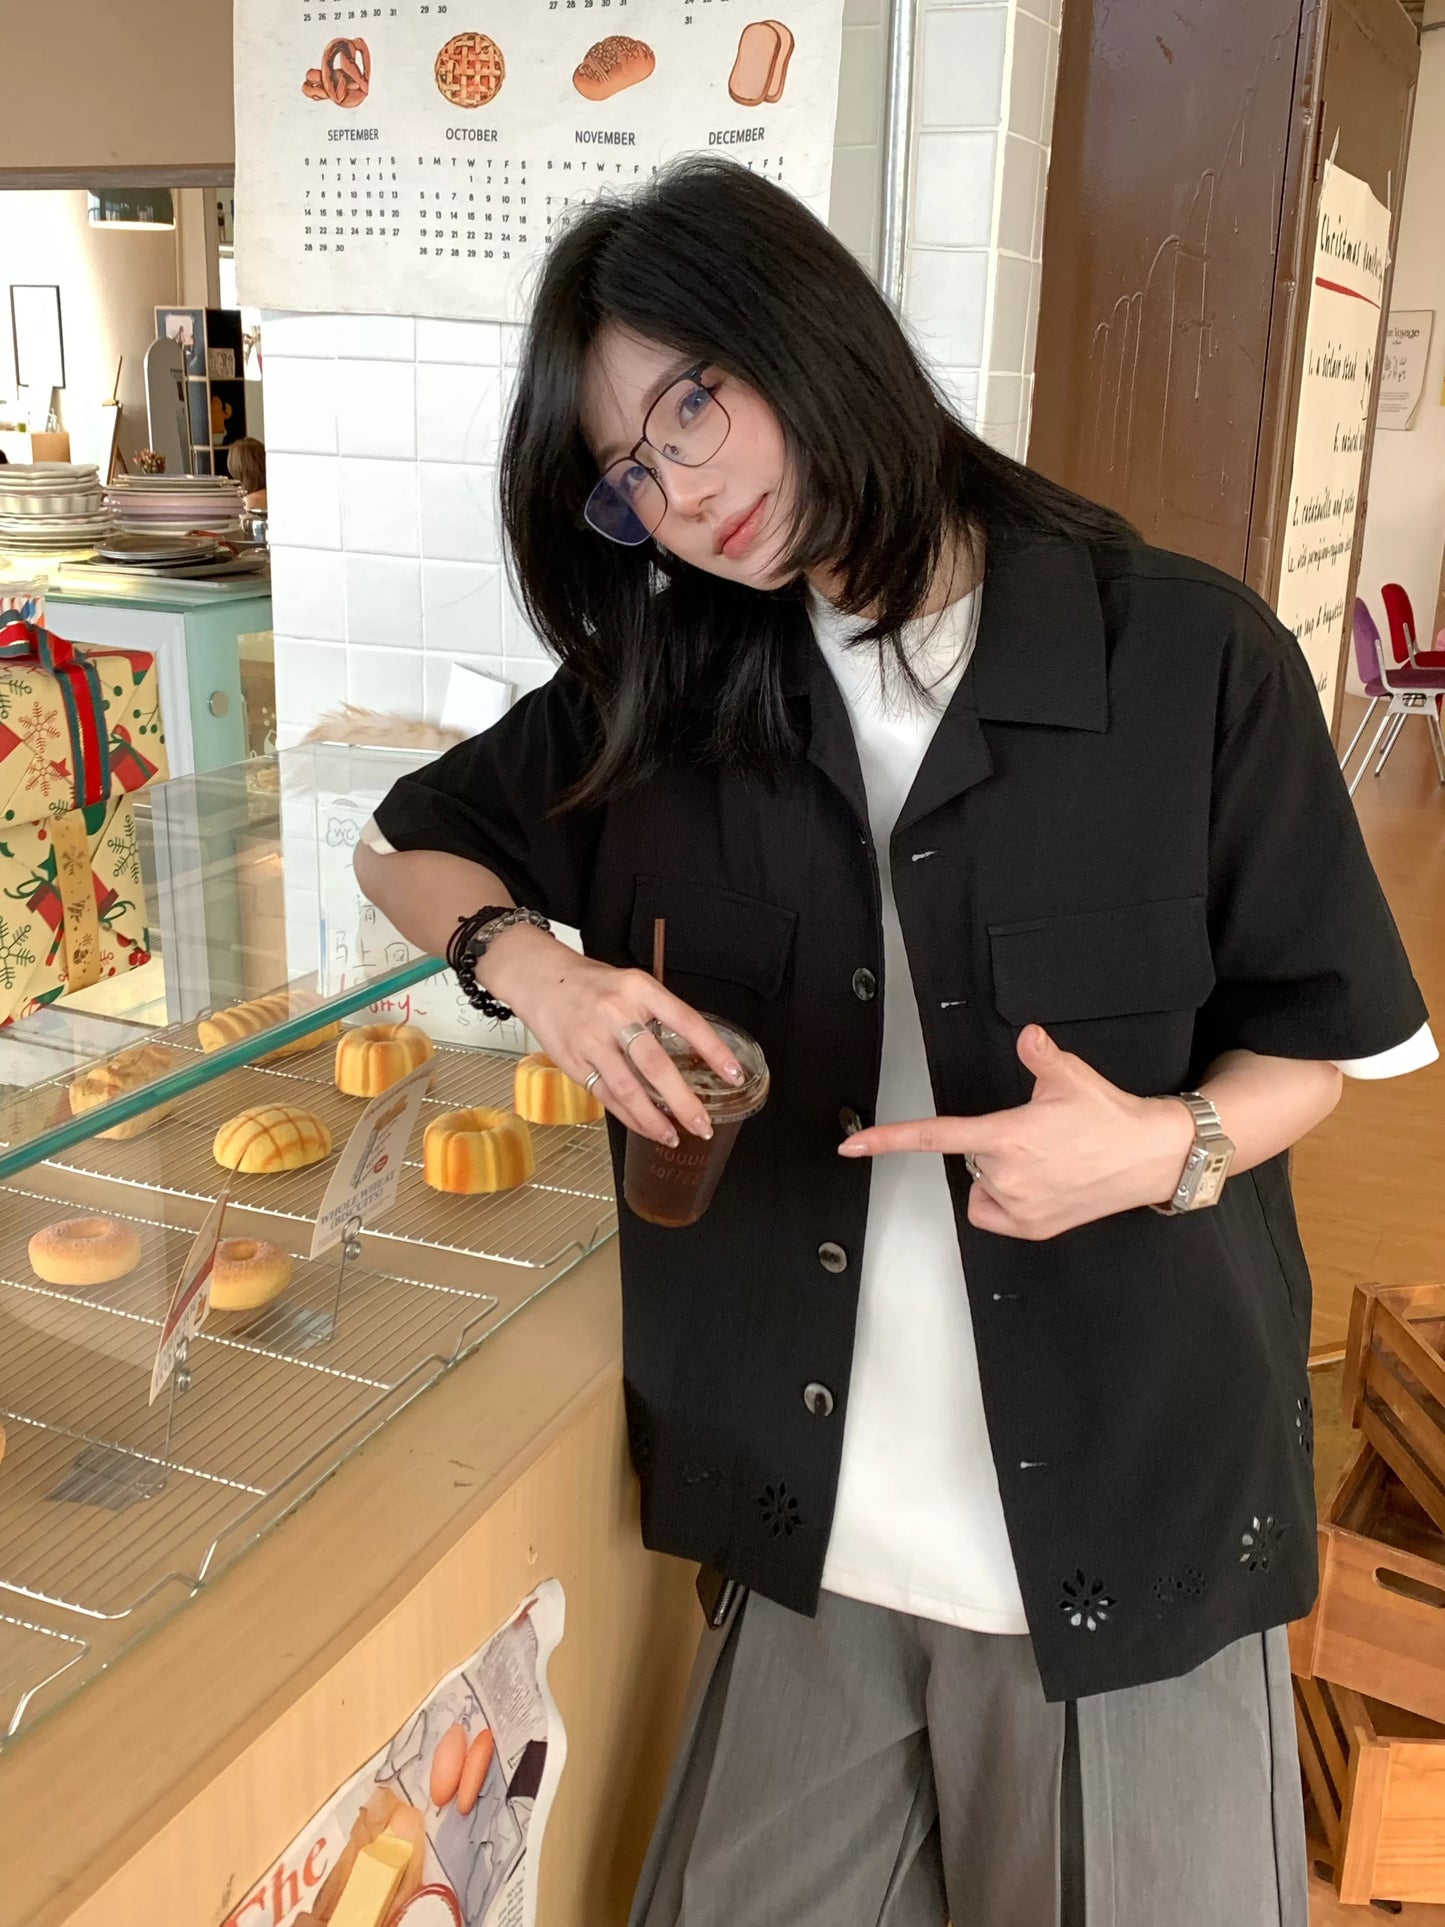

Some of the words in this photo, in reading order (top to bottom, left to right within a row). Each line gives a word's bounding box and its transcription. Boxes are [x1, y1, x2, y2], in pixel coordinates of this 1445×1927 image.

[419, 5, 430, 15] 29
[436, 4, 448, 14] 30
[548, 0, 559, 11] 27
[565, 0, 577, 9] 28
[583, 0, 594, 9] 29
[600, 0, 611, 8] 30
[303, 13, 312, 23] 25
[317, 12, 327, 21] 26
[333, 11, 343, 21] 27
[359, 9, 369, 19] 29
[372, 7, 382, 17] 30
[389, 7, 397, 17] 31
[684, 15, 693, 26] 31
[328, 128, 379, 141] SEPTEMBER
[446, 128, 498, 142] OCTOBER
[575, 130, 636, 146] NOVEMBER
[708, 127, 765, 145] DECEMBER
[304, 157, 311, 167] S
[319, 157, 328, 167] M
[335, 157, 342, 167] T
[349, 157, 358, 166] W
[365, 156, 371, 166] T
[377, 156, 383, 166] F
[390, 155, 396, 166] S
[417, 155, 424, 166] S
[432, 156, 442, 166] M
[451, 157, 457, 167] T
[466, 158, 476, 169] W
[486, 159, 493, 169] T
[503, 159, 510, 169] F
[520, 159, 527, 170] S
[546, 159, 553, 170] S
[562, 160, 572, 171] M
[581, 161, 588, 171] T
[595, 161, 605, 173] W
[615, 163, 622, 174] T
[633, 164, 640, 175] F
[763, 158, 769, 169] F
[778, 155, 784, 166] S
[305, 189, 311, 199] 7
[336, 190, 343, 199] 9
[349, 190, 358, 199] 10
[365, 190, 372, 199] 11
[391, 190, 399, 200] 13
[419, 190, 425, 200] 5
[434, 191, 441, 201] 6
[451, 191, 457, 201] 7
[468, 193, 475, 202] 8
[485, 194, 492, 203] 9
[501, 195, 511, 205] 10
[519, 195, 527, 205] 11
[303, 208, 312, 217] 14
[319, 208, 328, 217] 15
[335, 208, 344, 218] 16
[350, 208, 359, 217] 17
[365, 208, 373, 218] 18
[391, 209, 400, 219] 20
[419, 209, 427, 219] 12
[435, 210, 443, 220] 13
[449, 210, 459, 221] 14
[467, 211, 476, 221] 15
[484, 212, 493, 223] 16
[501, 213, 511, 223] 17
[518, 215, 527, 225] 18
[304, 225, 313, 235] 21
[318, 225, 328, 235] 22
[335, 226, 344, 236] 23
[350, 226, 360, 236] 24
[365, 226, 375, 236] 25
[391, 227, 401, 237] 27
[419, 228, 428, 238] 19
[434, 229, 445, 239] 20
[450, 229, 459, 239] 21
[466, 230, 477, 240] 22
[483, 231, 493, 241] 23
[500, 232, 511, 242] 24
[517, 233, 528, 243] 25
[1320, 213, 1361, 266] Christmas
[303, 243, 314, 252] 28
[318, 243, 328, 252] 29
[334, 243, 345, 253] 30
[418, 246, 429, 256] 26
[435, 247, 445, 257] 27
[450, 247, 460, 257] 28
[466, 248, 477, 259] 29
[483, 249, 495, 259] 30
[502, 250, 511, 260] 31
[334, 828, 356, 842] WC
[320, 1194, 358, 1226] WHOLE
[360, 1169, 397, 1200] WHEAT
